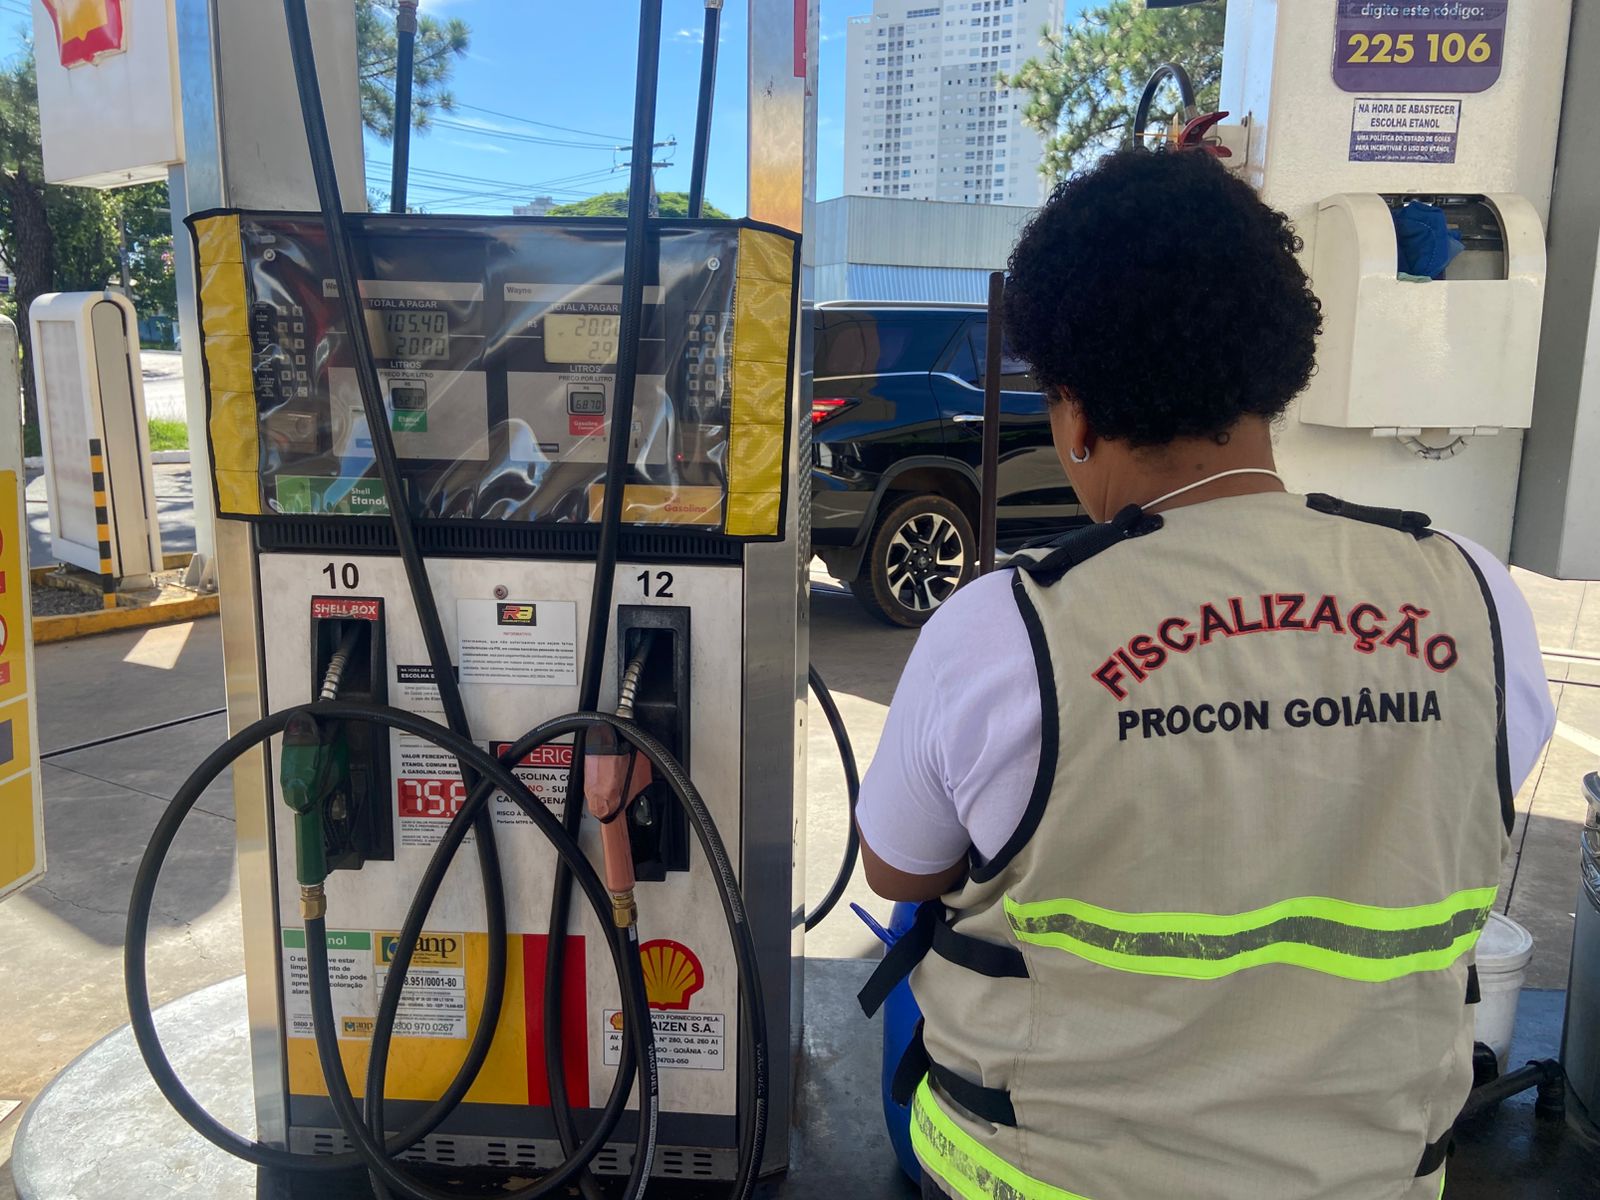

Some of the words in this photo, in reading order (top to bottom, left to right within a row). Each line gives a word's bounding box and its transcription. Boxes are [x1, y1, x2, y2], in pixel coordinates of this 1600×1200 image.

[1361, 2, 1399, 19] digite
[1402, 4, 1431, 16] este
[1433, 2, 1485, 19] código:
[1346, 33, 1415, 64] 225
[1427, 32, 1491, 64] 106
[1358, 104, 1370, 113] NA
[1371, 104, 1394, 113] HORA
[1396, 104, 1407, 113] DE
[1408, 105, 1455, 115] ABASTECER
[1370, 118, 1407, 128] ESCOLHA
[1409, 119, 1440, 128] ETANOL
[506, 287, 532, 295] Wayne
[368, 299, 396, 308] TOTAL
[398, 300, 405, 308] A
[407, 300, 438, 309] PAGAR
[551, 303, 578, 311] TOTAL
[588, 304, 619, 312] PAGAR
[588, 341, 613, 360] 2.9
[390, 360, 422, 369] LITROS
[569, 364, 601, 373] LITROS
[351, 487, 370, 495] Shell
[351, 496, 386, 505] Etanol
[322, 562, 360, 590] 10
[636, 570, 674, 598] 12
[314, 603, 348, 614] SHELL
[350, 604, 377, 615] BOX
[1091, 593, 1459, 701] FISCALIZAÇÃO
[1118, 700, 1270, 741] PROCON
[1284, 687, 1442, 728] GOIÂNIA
[530, 748, 573, 764] ERIG
[515, 772, 557, 781] ASOLINA
[327, 935, 347, 945] nol
[414, 936, 457, 958] anp
[349, 974, 368, 982] pode
[414, 1023, 431, 1031] 970
[432, 1023, 455, 1032] 0267
[652, 1021, 687, 1032] AIZEN
[691, 1023, 715, 1033] S.A.
[673, 1047, 702, 1055] GOIÂNIA
